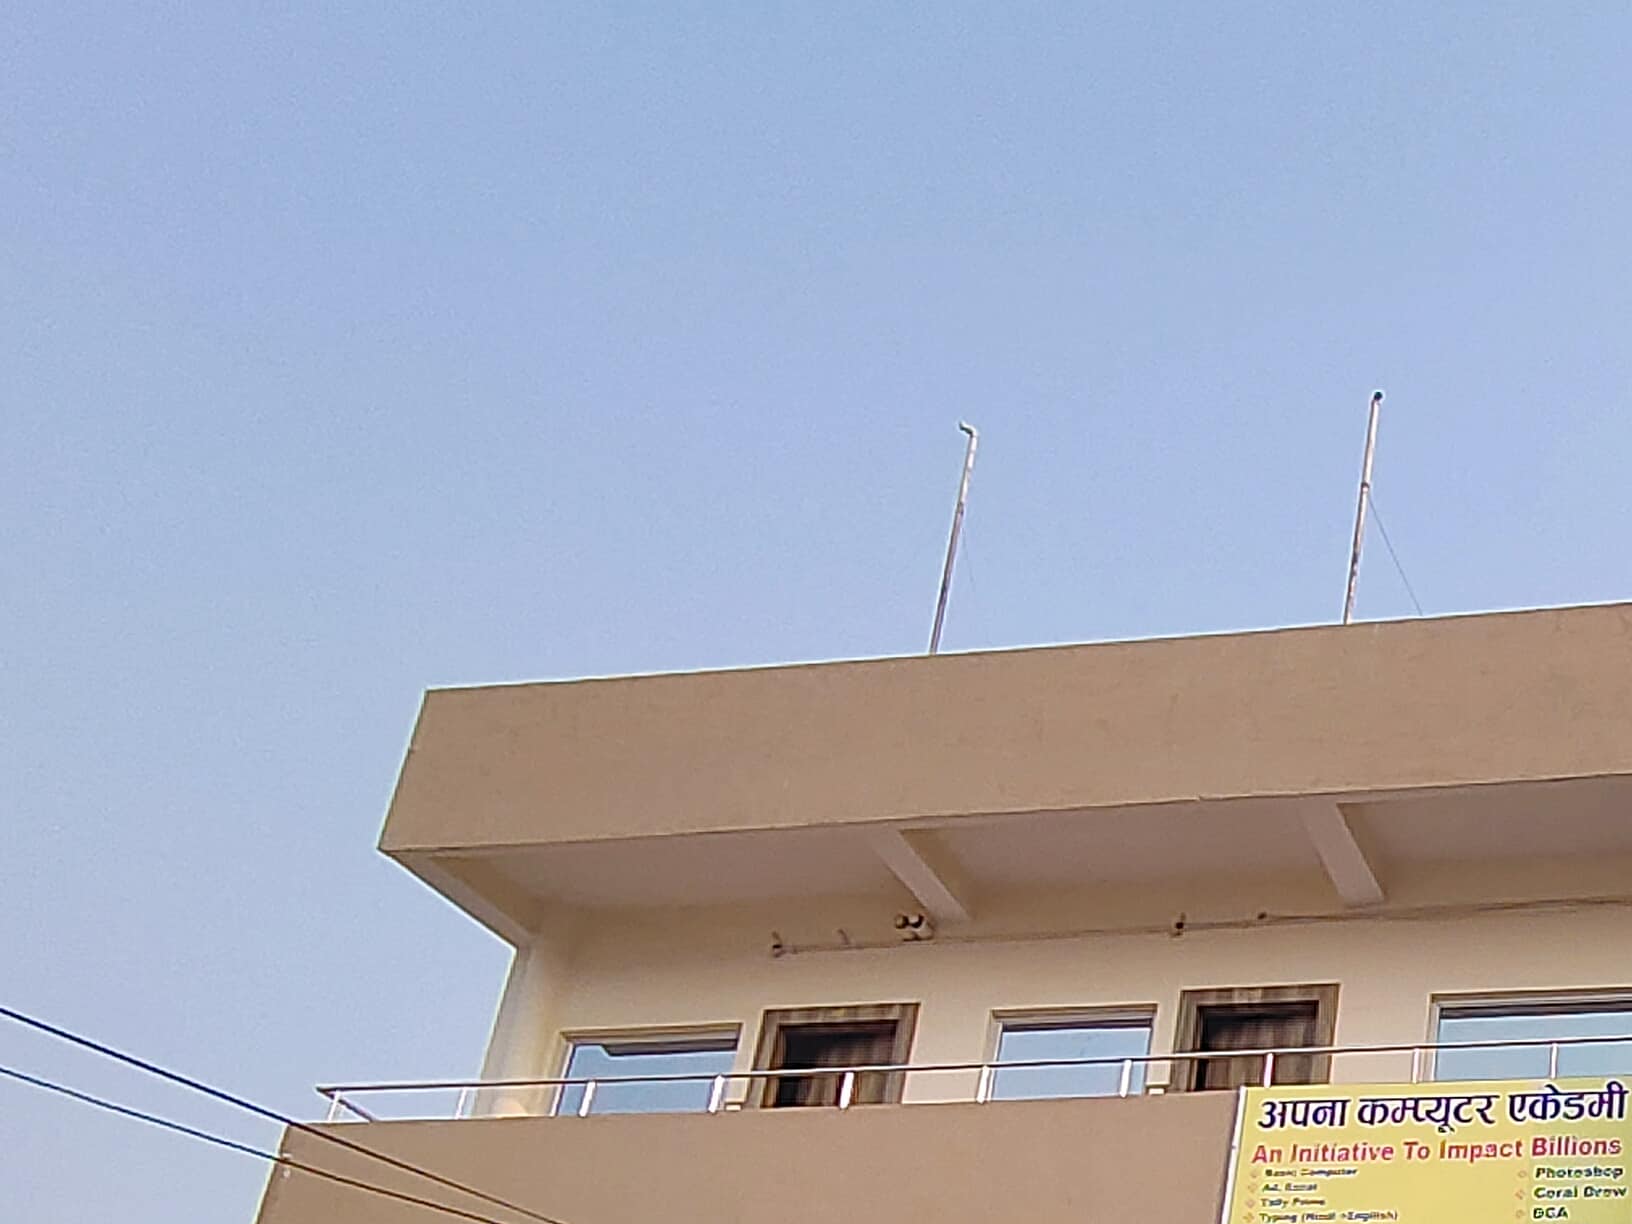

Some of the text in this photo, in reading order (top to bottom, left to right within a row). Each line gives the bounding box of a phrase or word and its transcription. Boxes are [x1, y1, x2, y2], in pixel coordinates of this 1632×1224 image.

[1258, 1081, 1629, 1132] अपना कम्प्यूटर एकेडमी
[1252, 1136, 1621, 1164] An Initiative To Impact Billions
[1535, 1167, 1623, 1180] Photoshop
